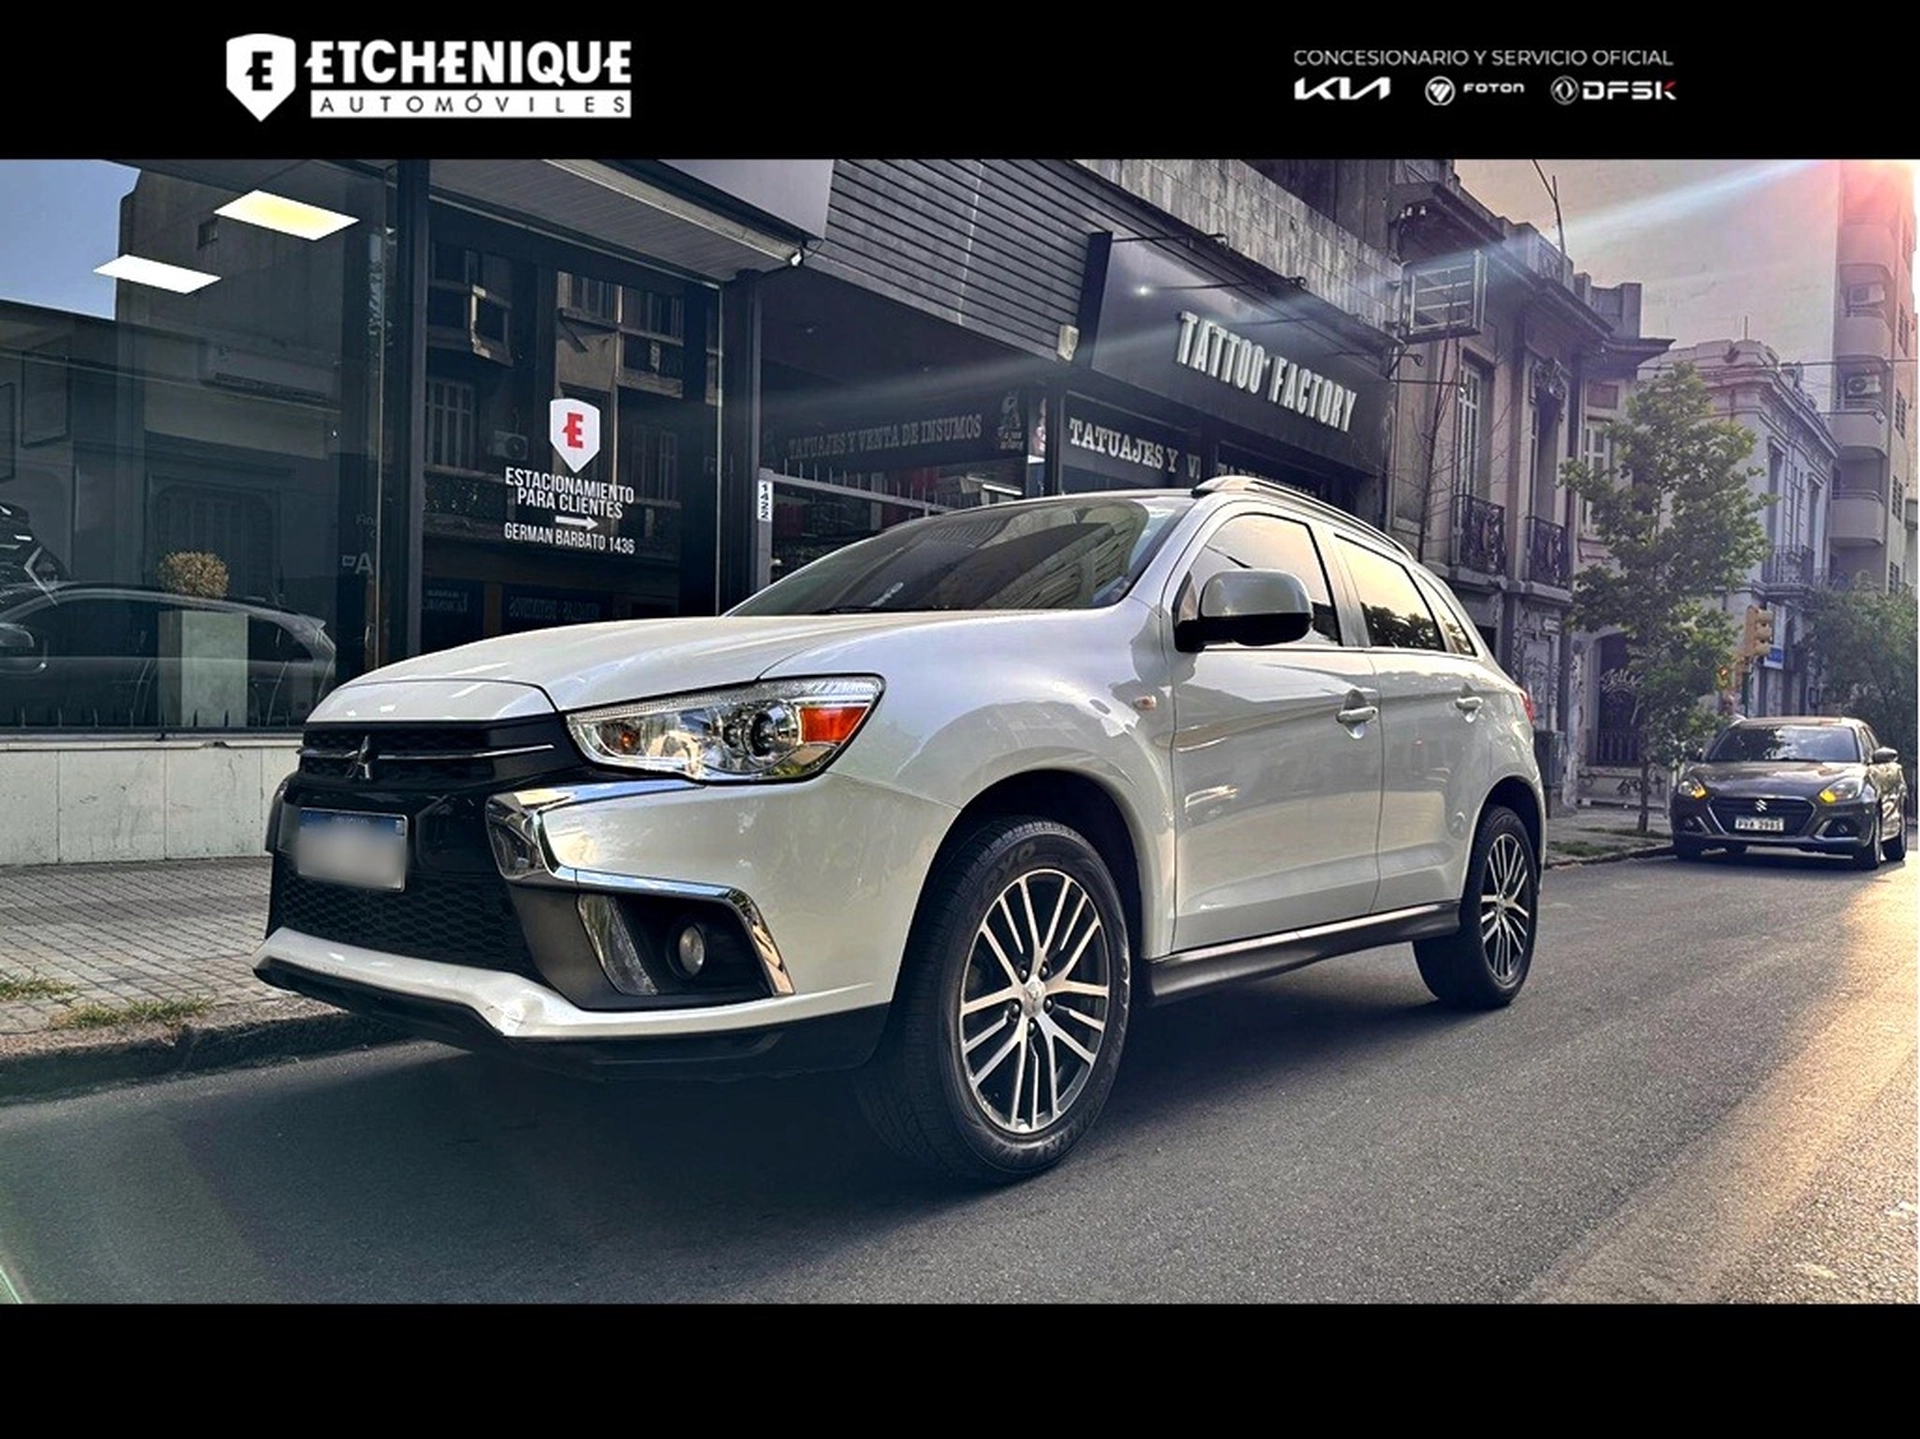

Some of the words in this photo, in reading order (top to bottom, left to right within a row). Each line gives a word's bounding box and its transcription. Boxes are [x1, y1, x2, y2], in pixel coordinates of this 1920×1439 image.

[1177, 310, 1265, 395] TATTOO
[1268, 355, 1357, 432] FACTORY
[902, 421, 919, 446] DE
[921, 413, 983, 443] INSUMOS
[1069, 417, 1163, 470] TATUAJES
[1166, 447, 1179, 473] Y
[505, 466, 635, 504] ESTACIONAMIENTO
[517, 487, 556, 511] PARA
[559, 494, 623, 519] CLIENTES
[504, 522, 554, 544] GERMAN
[555, 528, 606, 551] BARBATO
